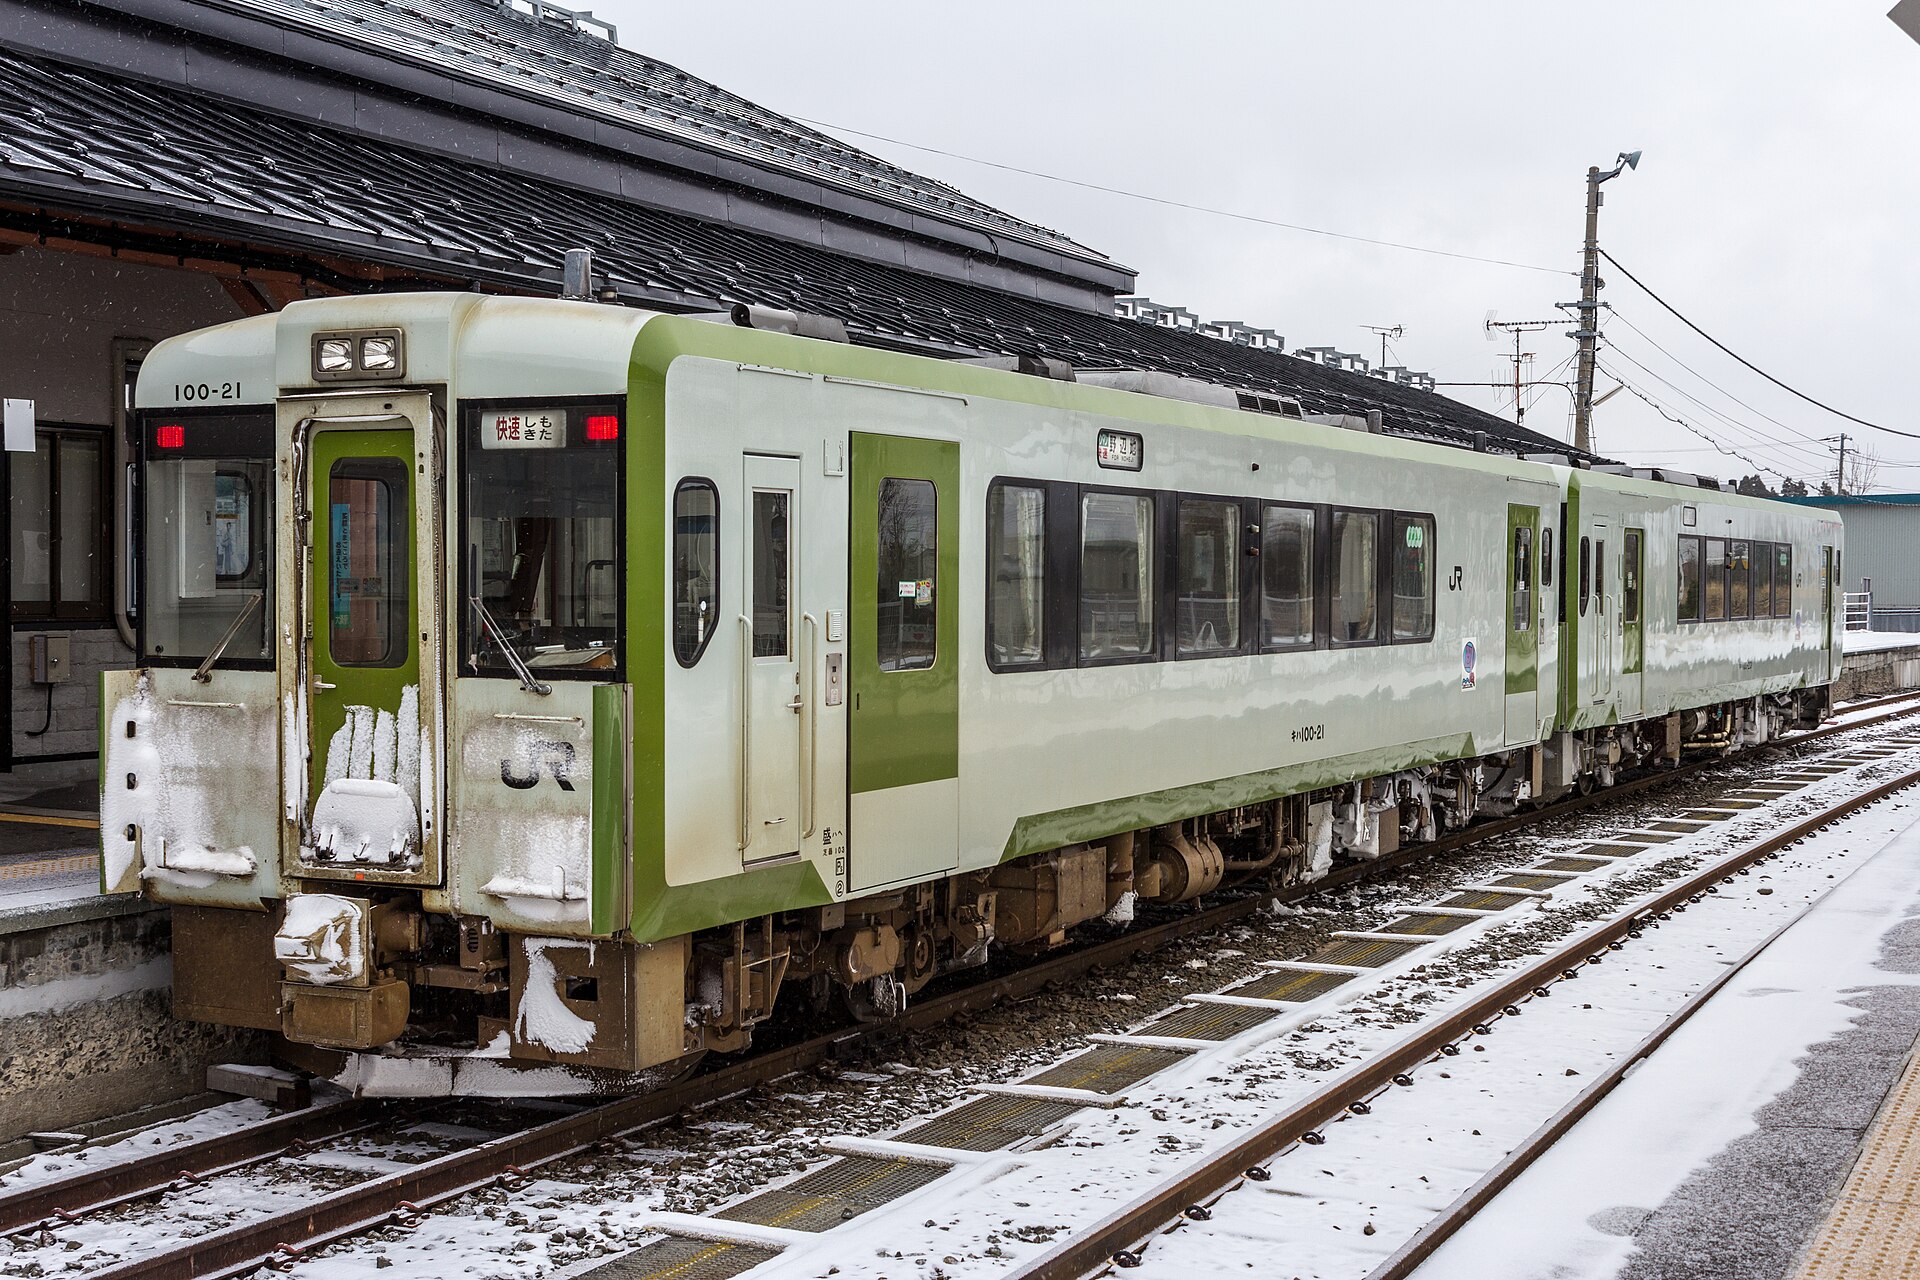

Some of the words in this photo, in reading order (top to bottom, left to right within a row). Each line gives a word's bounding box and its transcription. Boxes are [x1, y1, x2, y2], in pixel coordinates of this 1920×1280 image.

[175, 381, 241, 402] 100-21
[496, 416, 520, 441] 快速
[1449, 565, 1462, 592] JR
[501, 740, 576, 792] JR
